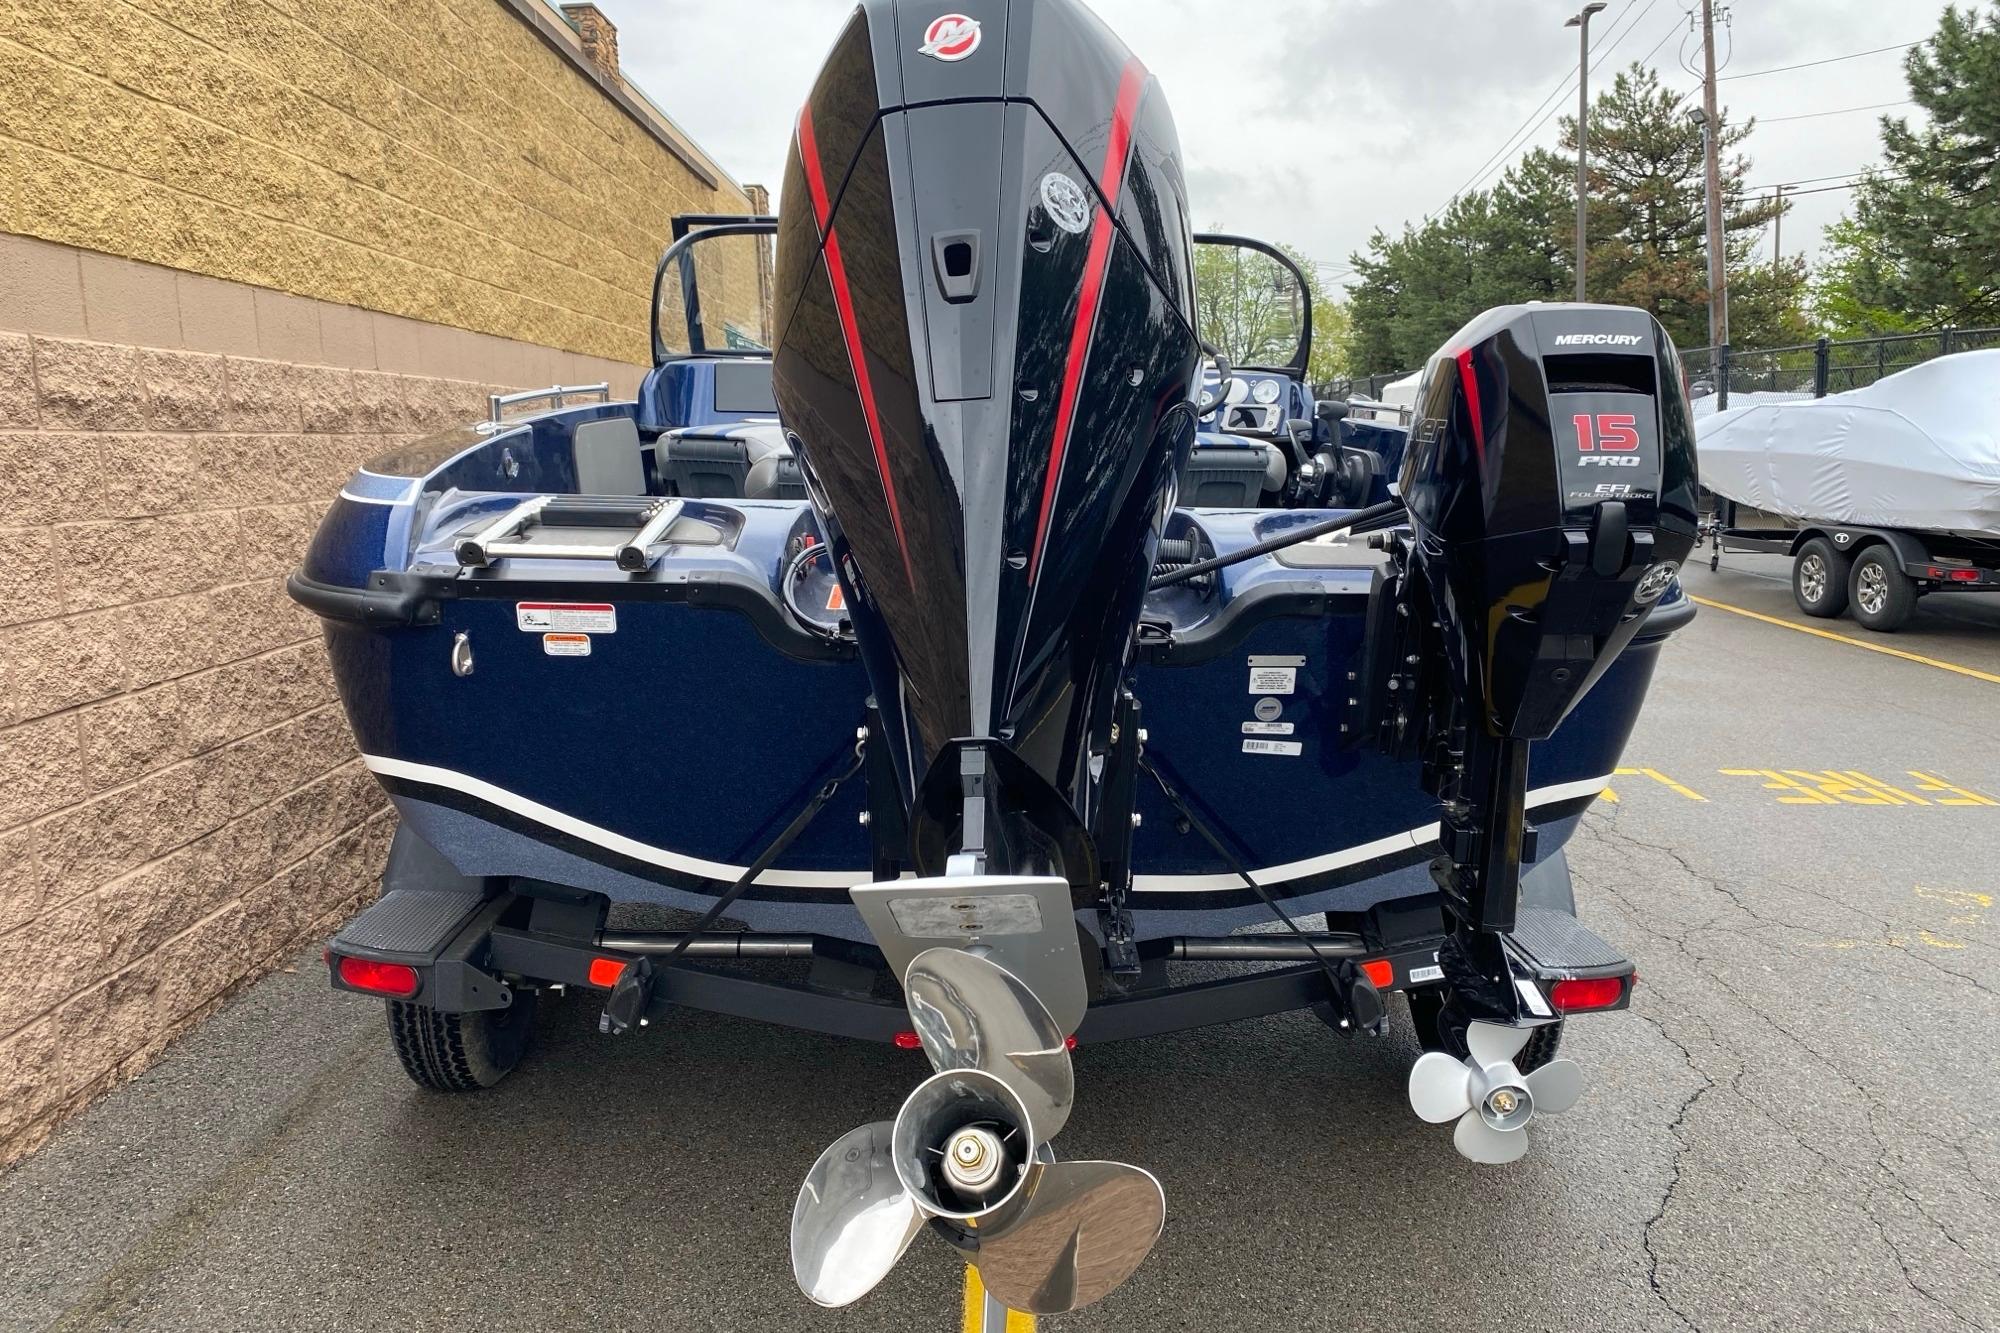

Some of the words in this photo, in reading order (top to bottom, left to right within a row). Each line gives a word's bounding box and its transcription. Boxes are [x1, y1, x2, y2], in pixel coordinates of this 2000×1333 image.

[1555, 334, 1643, 346] MERCURY
[1573, 414, 1640, 452] 15
[1577, 456, 1640, 467] PRO
[1594, 484, 1631, 493] EFI
